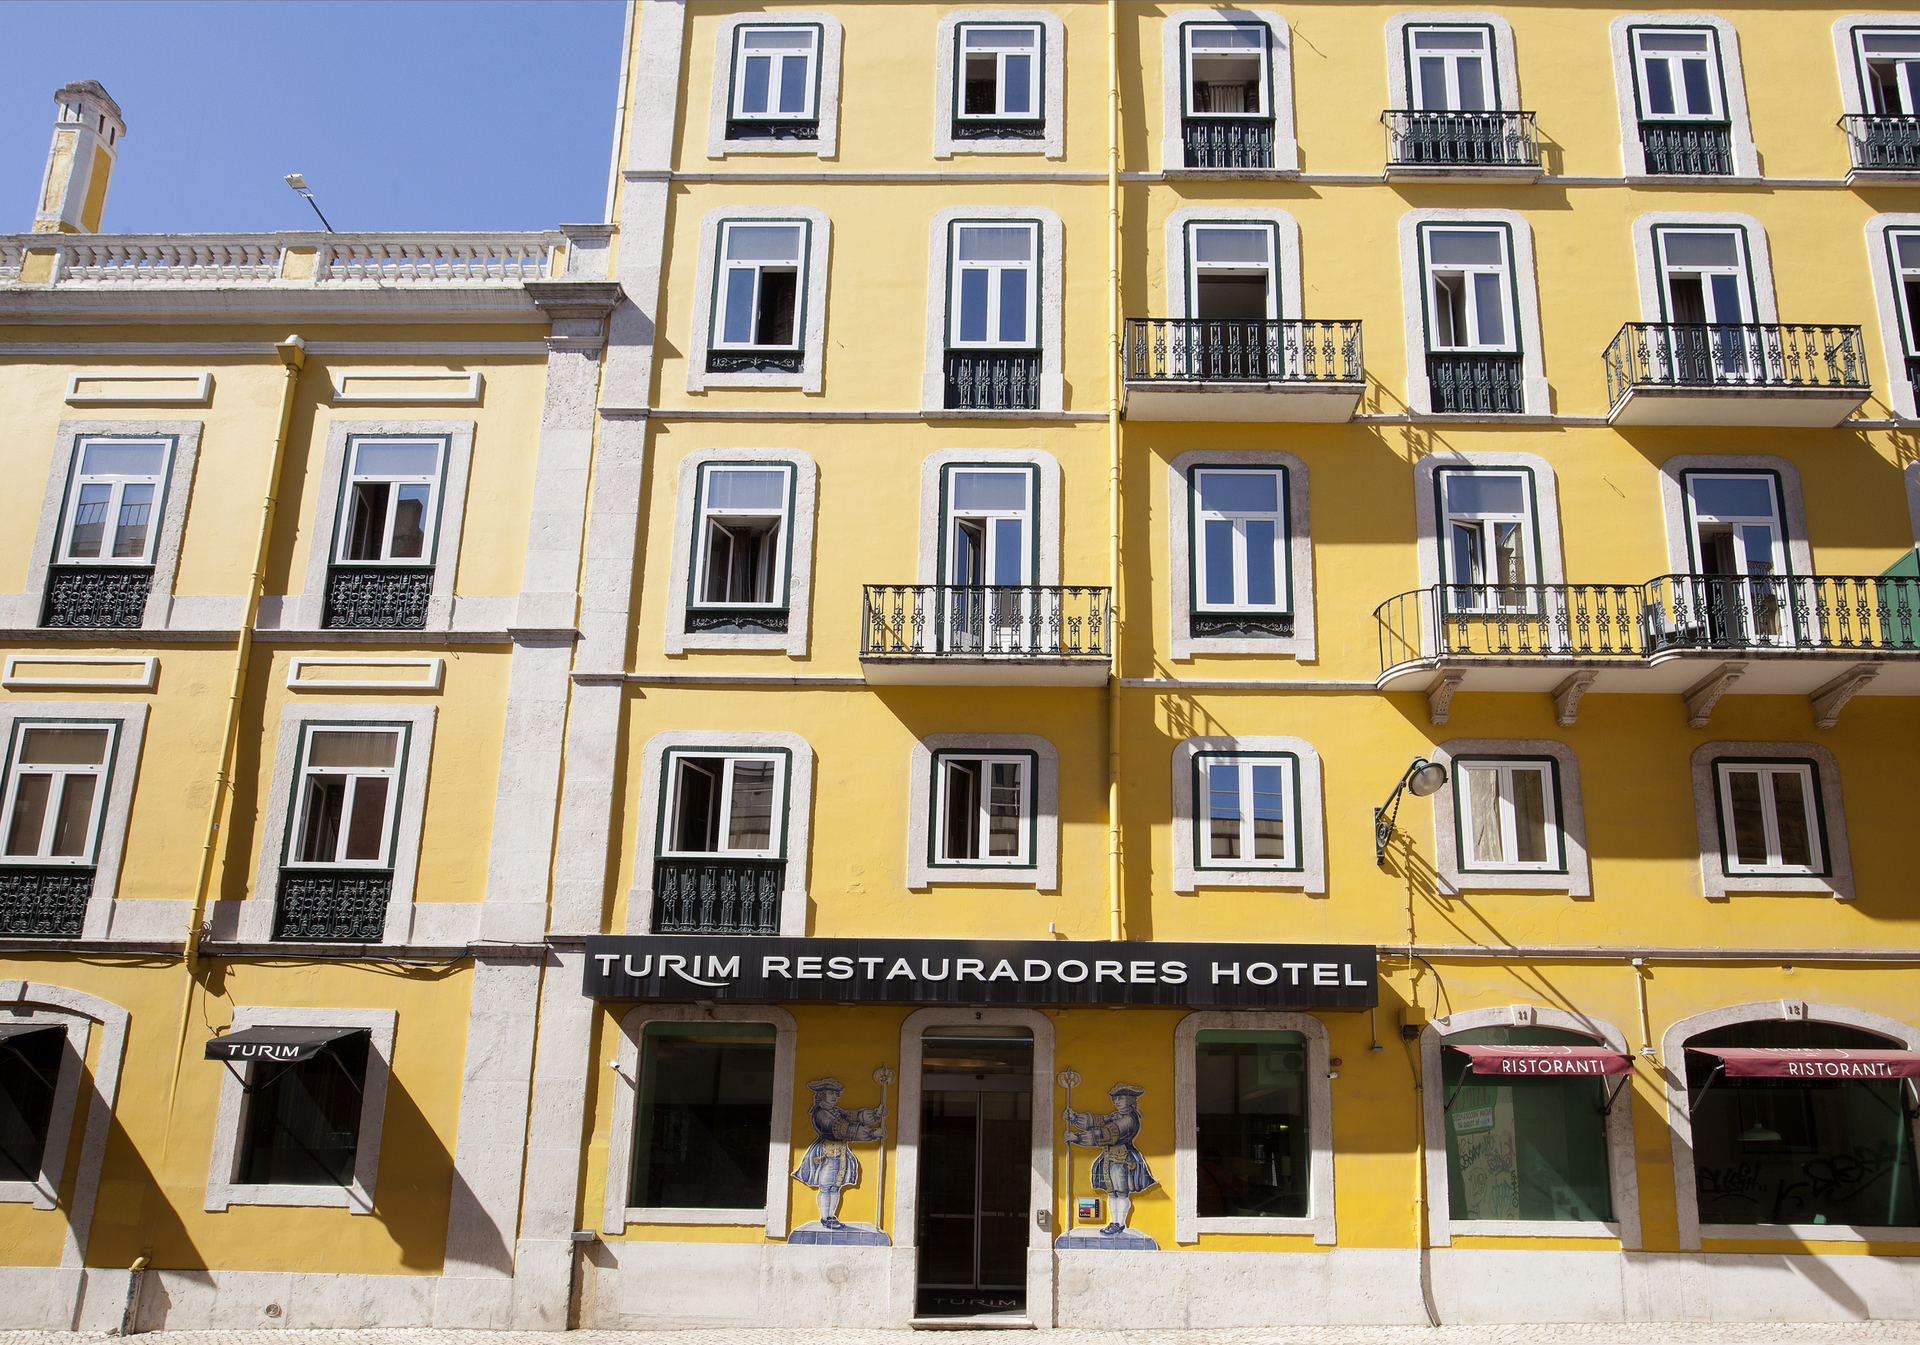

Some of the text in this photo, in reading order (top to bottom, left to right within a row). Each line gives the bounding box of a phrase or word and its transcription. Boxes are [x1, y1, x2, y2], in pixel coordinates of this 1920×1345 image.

[594, 953, 1369, 987] TURIM RESTAURADORES HOTEL
[1518, 1010, 1528, 1021] 11
[227, 1044, 300, 1061] TURIM
[1502, 1059, 1605, 1074] RISTORANTI
[1788, 1062, 1893, 1076] RISTORANTI
[932, 1297, 1017, 1308] TURIM
